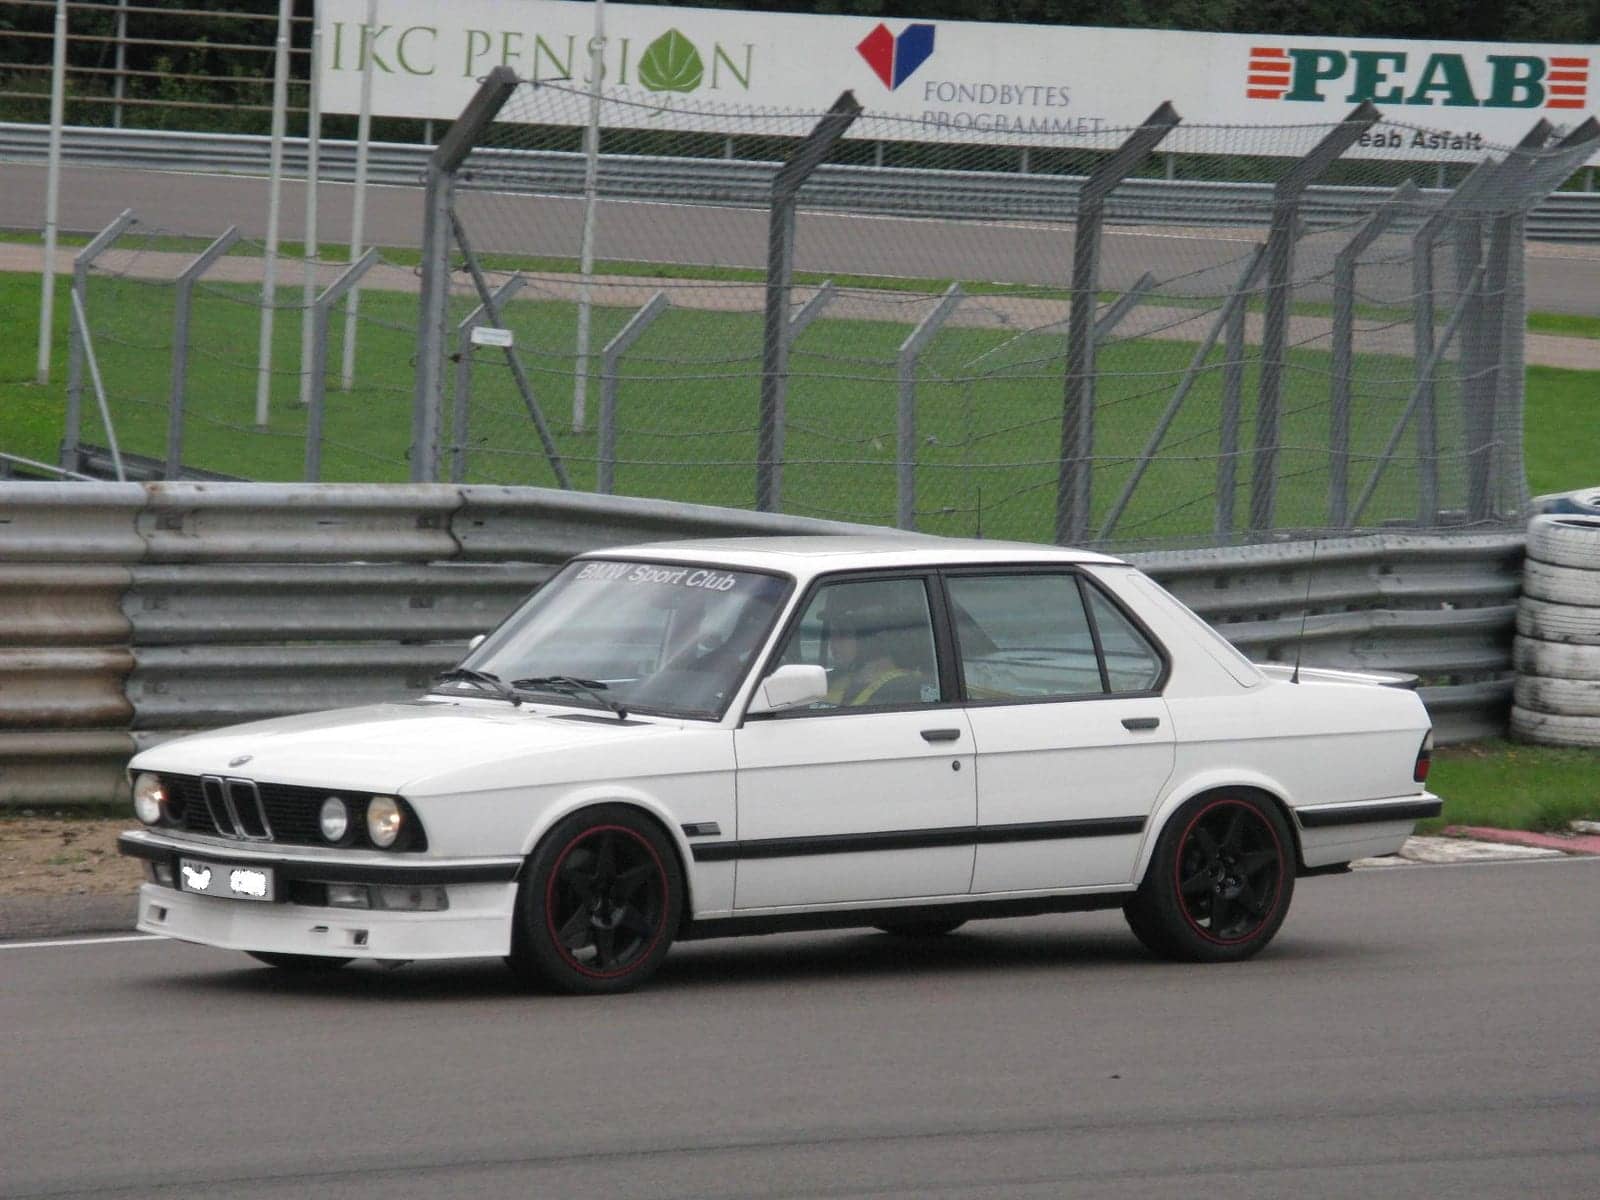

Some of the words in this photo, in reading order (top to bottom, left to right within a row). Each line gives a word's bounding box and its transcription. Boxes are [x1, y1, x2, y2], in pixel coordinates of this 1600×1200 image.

[330, 21, 438, 76] IKC
[1284, 47, 1548, 109] PEAB
[923, 80, 1072, 107] FONDBYTES
[922, 109, 1105, 137] PROGRAMMET
[1358, 128, 1402, 148] eab
[1411, 129, 1482, 150] Asfalt
[628, 565, 687, 585] Sport
[686, 569, 736, 592] Club
